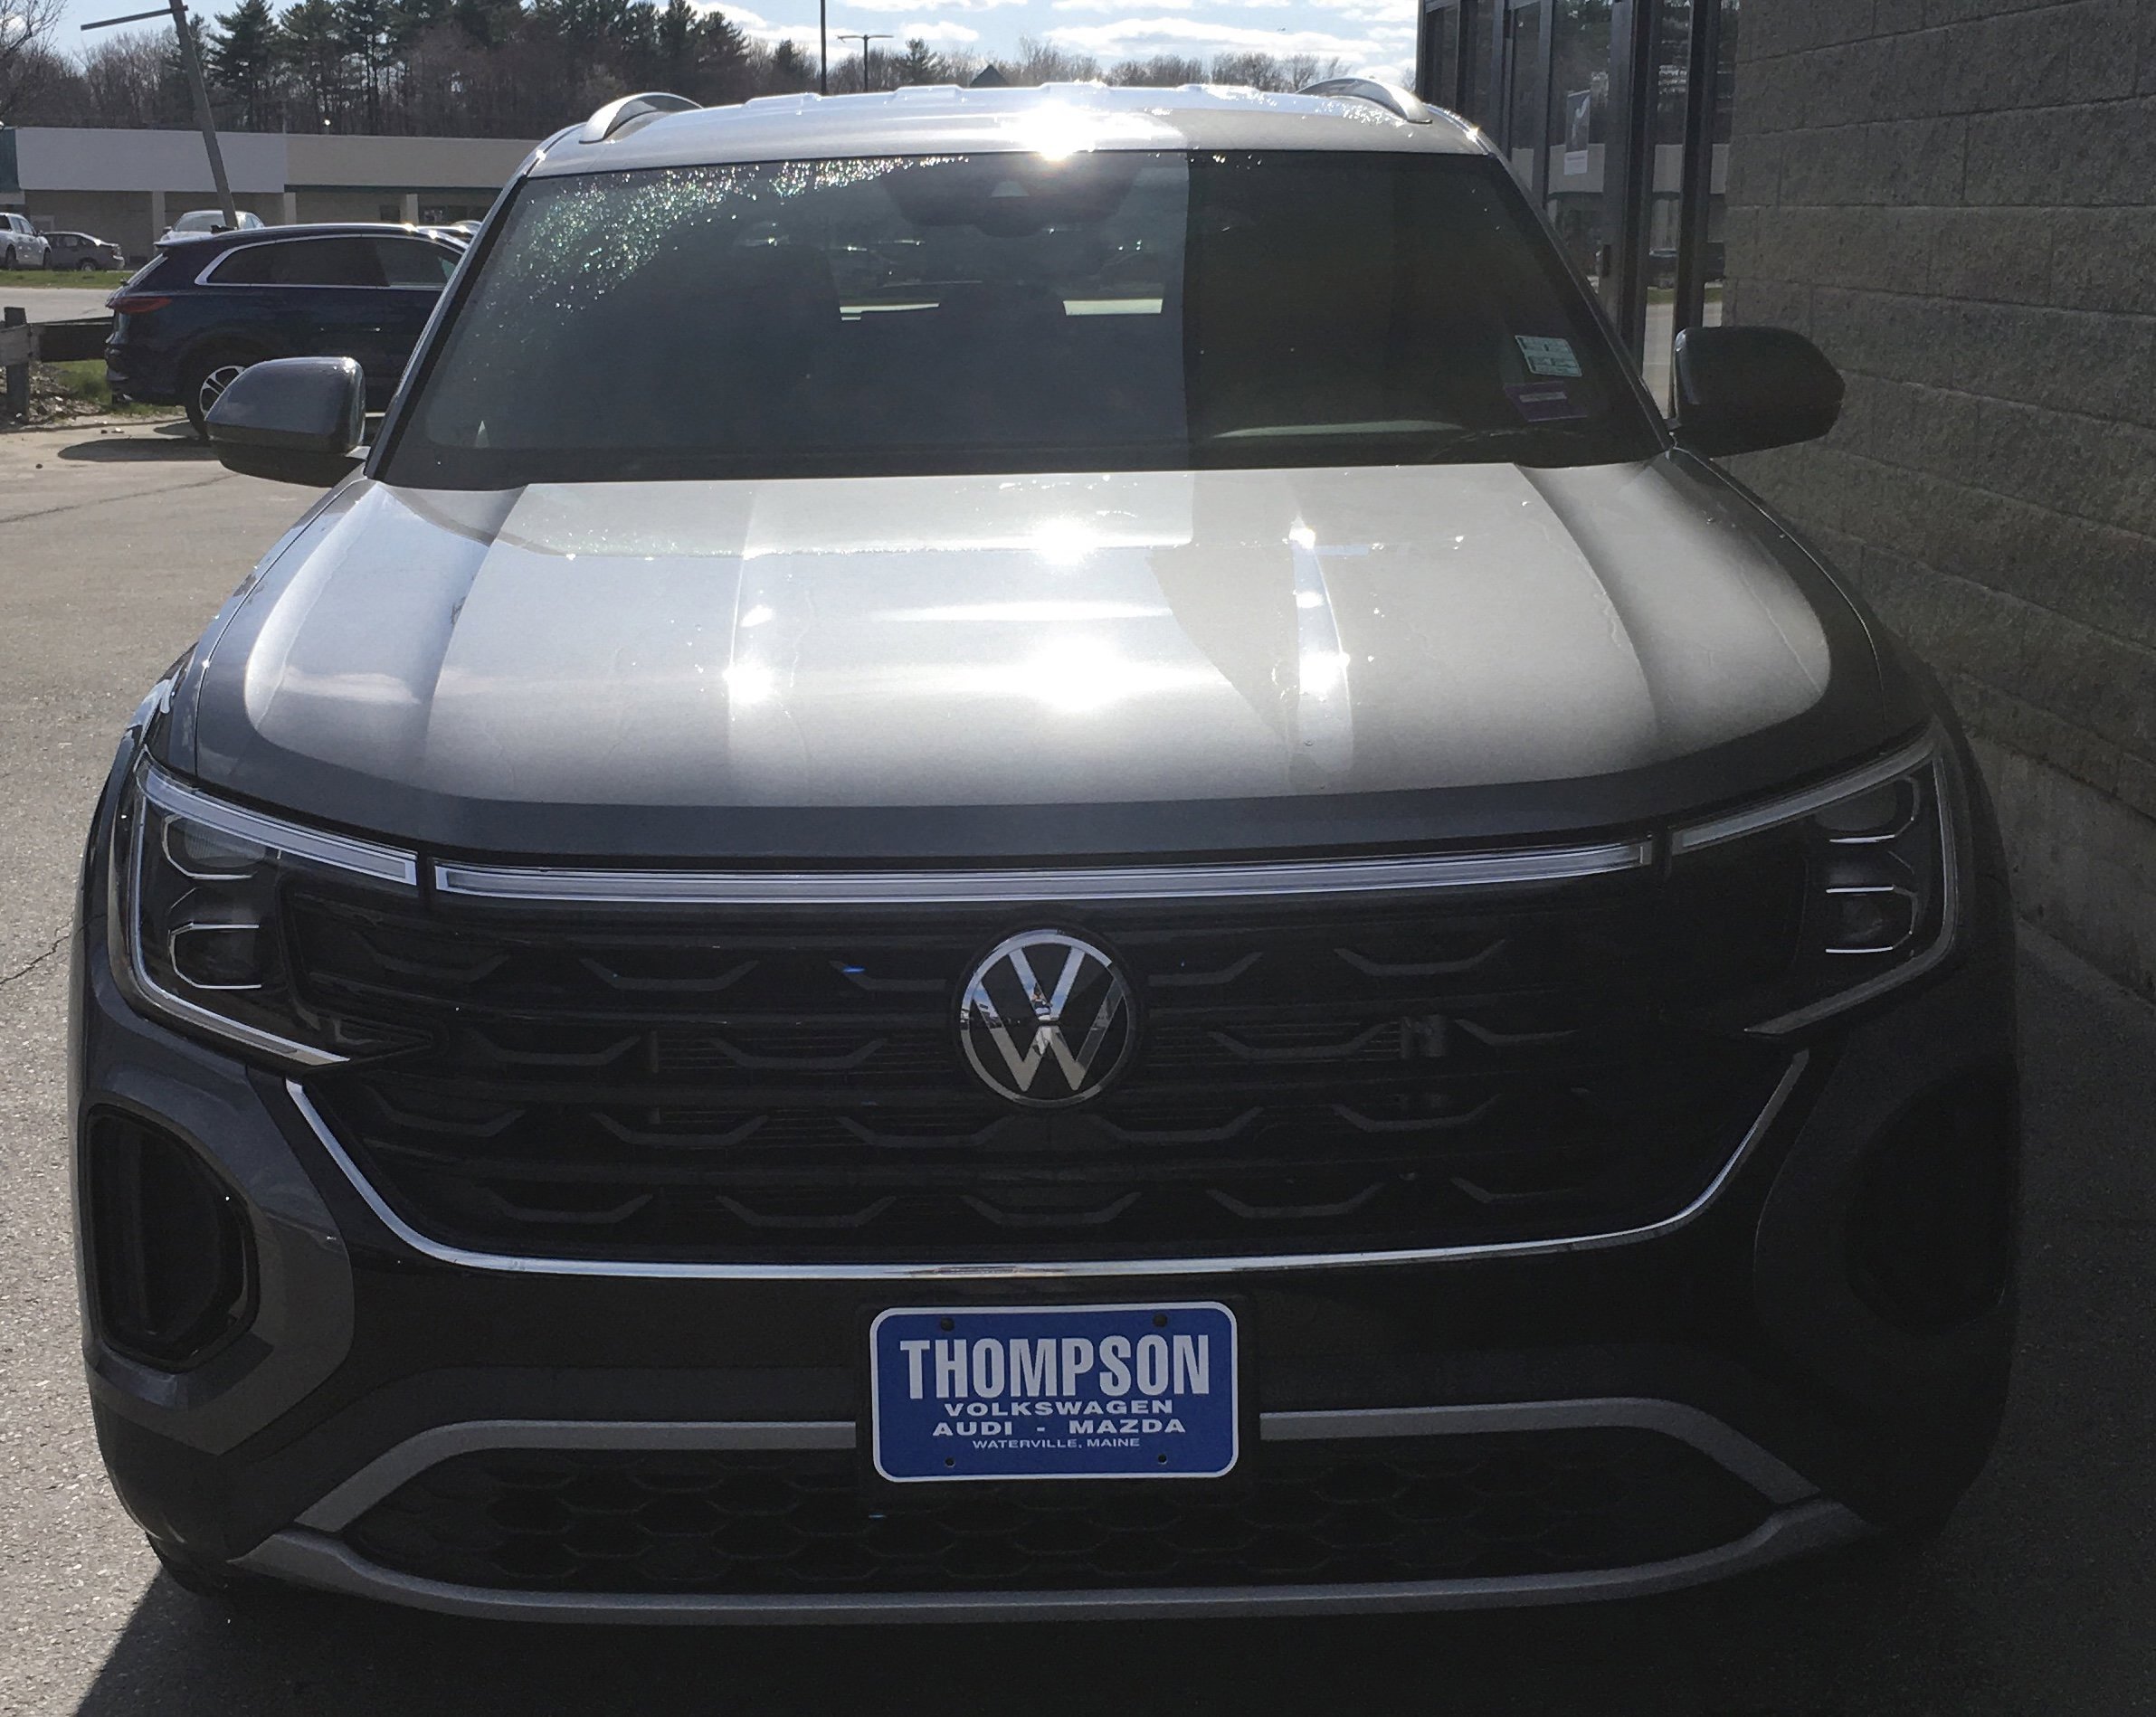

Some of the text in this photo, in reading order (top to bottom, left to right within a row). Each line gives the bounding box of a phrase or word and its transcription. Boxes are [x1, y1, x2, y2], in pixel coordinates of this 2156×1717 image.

[899, 1334, 1210, 1399] THOMPSON
[944, 1399, 1173, 1417] VOLKSWAGEN
[932, 1420, 1012, 1437] AUDI
[1069, 1418, 1186, 1435] MAZDA
[972, 1437, 1141, 1449] WATERVILLE, MAINE
